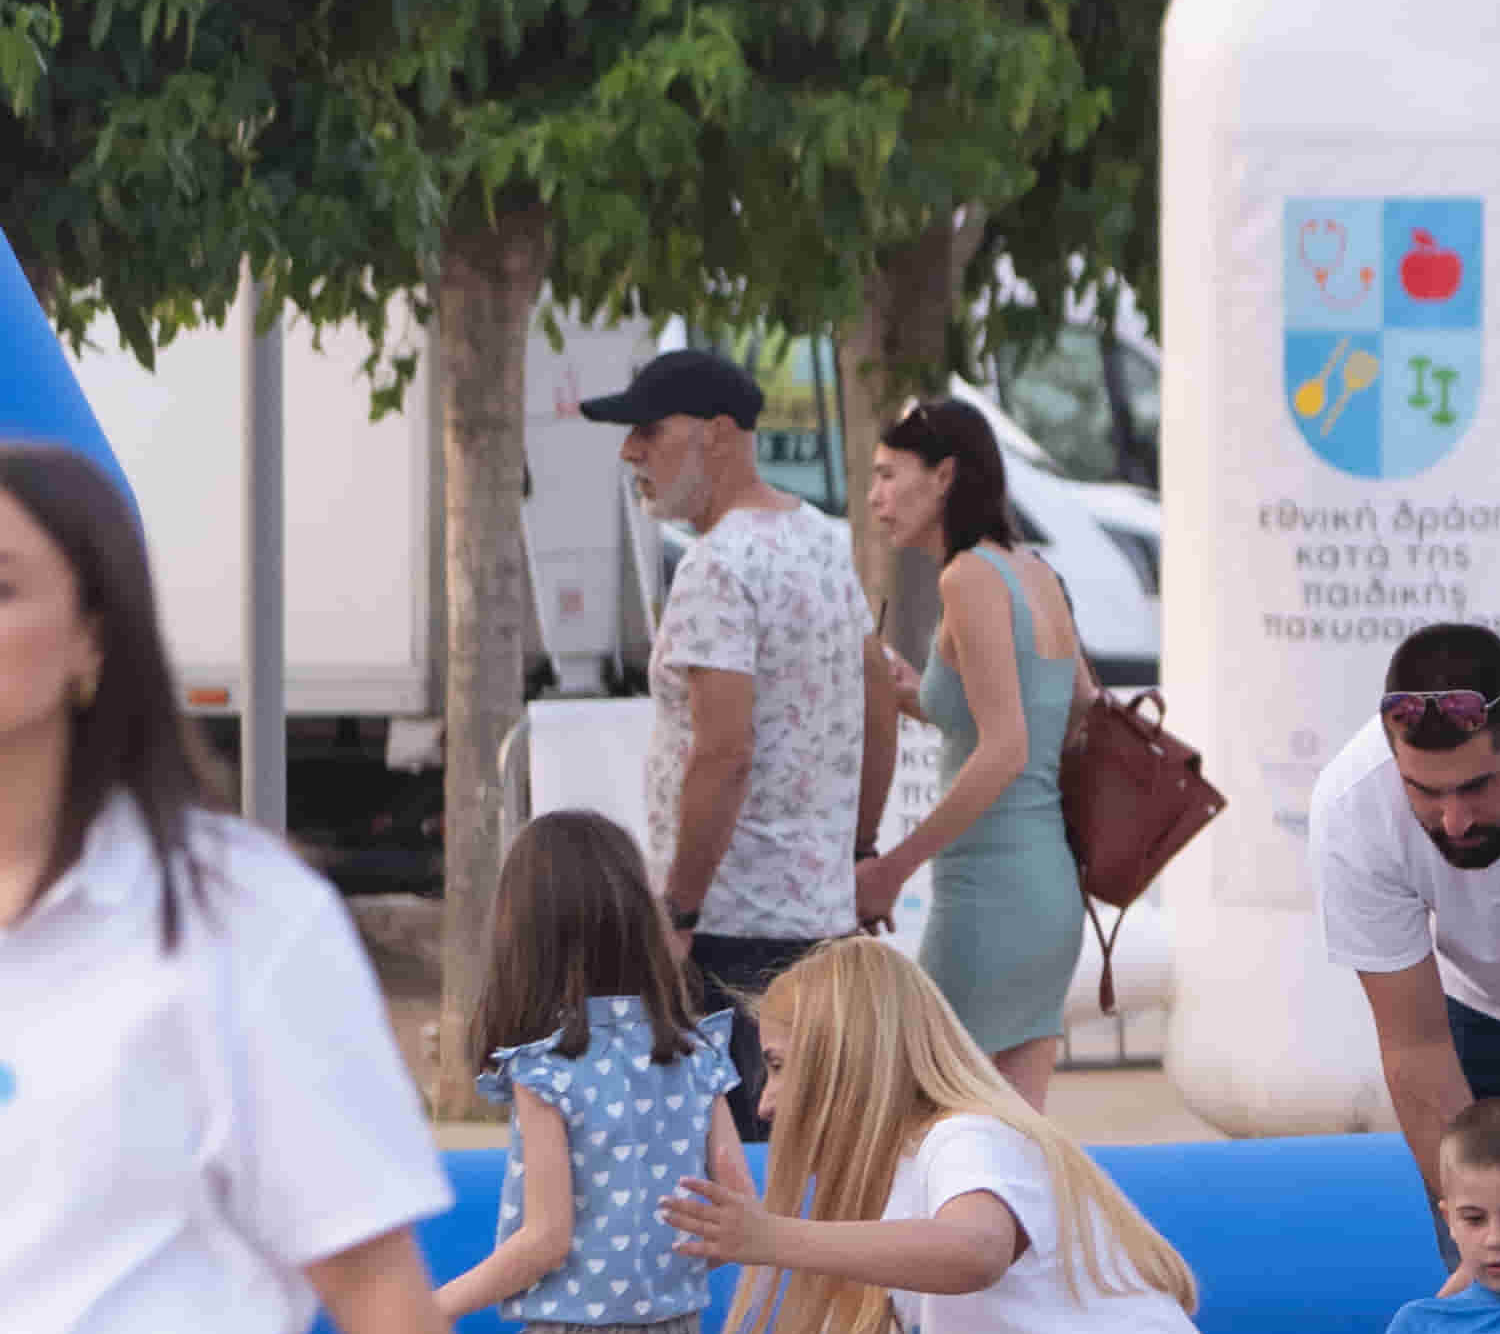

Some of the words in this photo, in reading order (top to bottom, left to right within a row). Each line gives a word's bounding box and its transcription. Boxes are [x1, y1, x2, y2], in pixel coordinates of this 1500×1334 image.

[1258, 497, 1377, 531] εθνική
[1296, 538, 1390, 570] κατά
[1408, 543, 1472, 571] της
[1304, 575, 1467, 617] παιδικής
